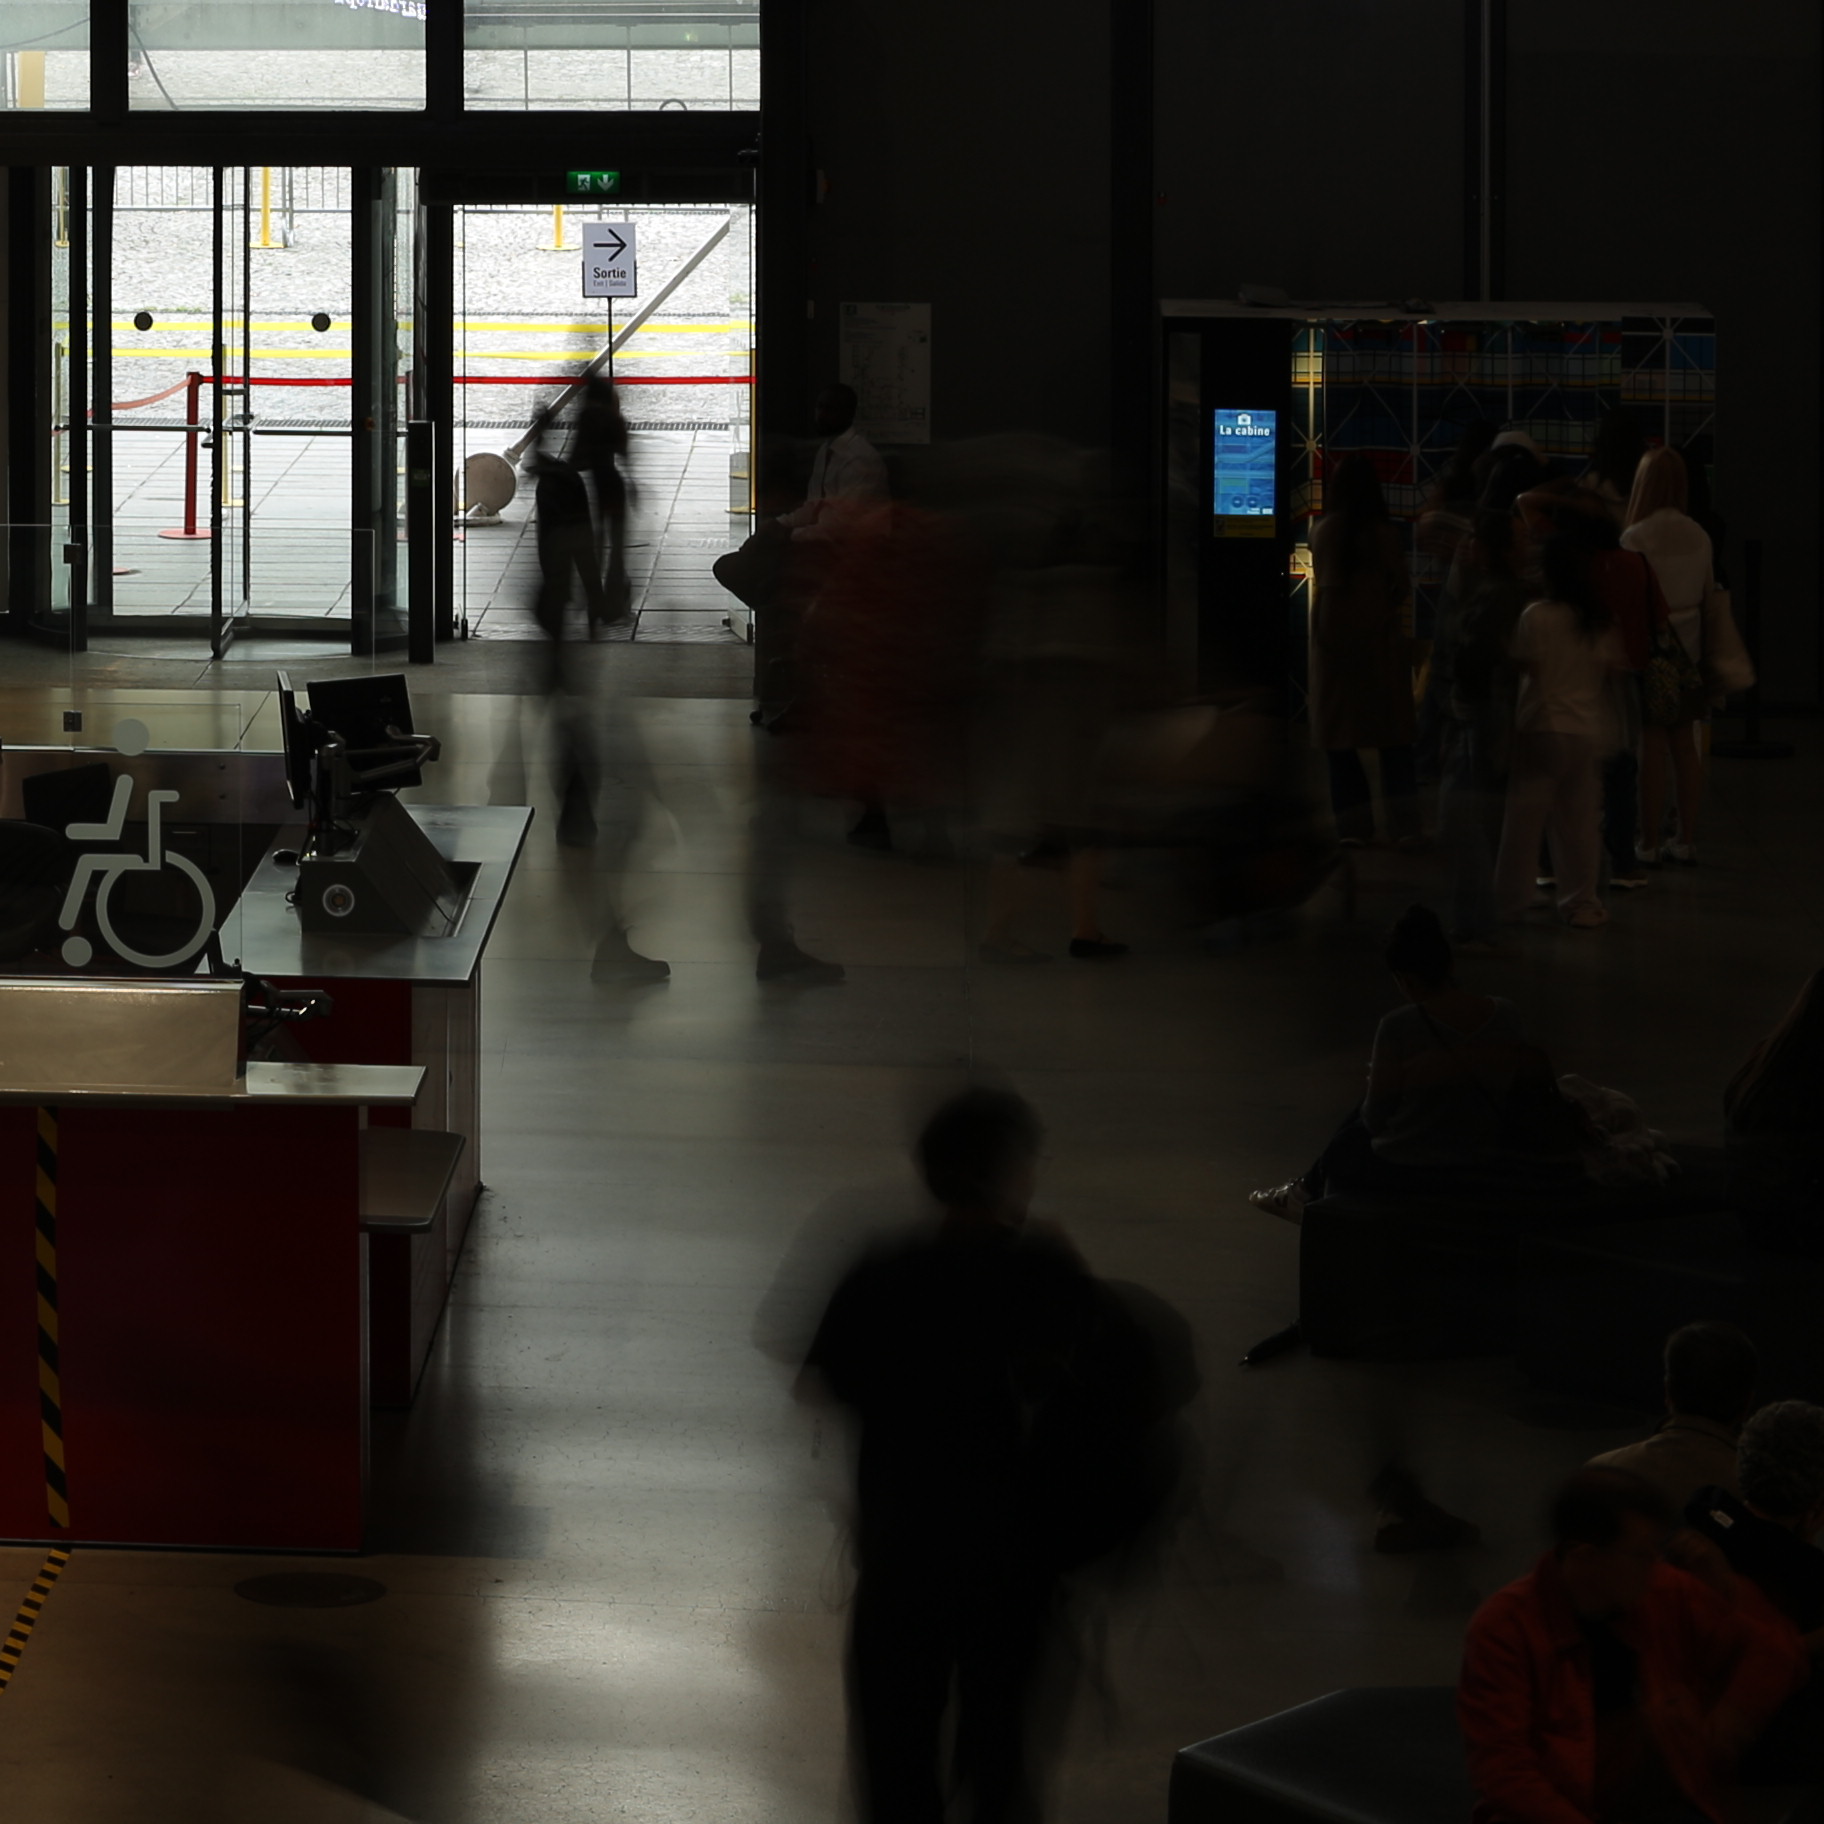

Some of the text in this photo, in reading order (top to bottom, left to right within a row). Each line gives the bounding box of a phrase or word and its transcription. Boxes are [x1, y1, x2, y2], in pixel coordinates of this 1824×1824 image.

[593, 267, 627, 279] Sortie
[1219, 425, 1271, 436] La cabine
